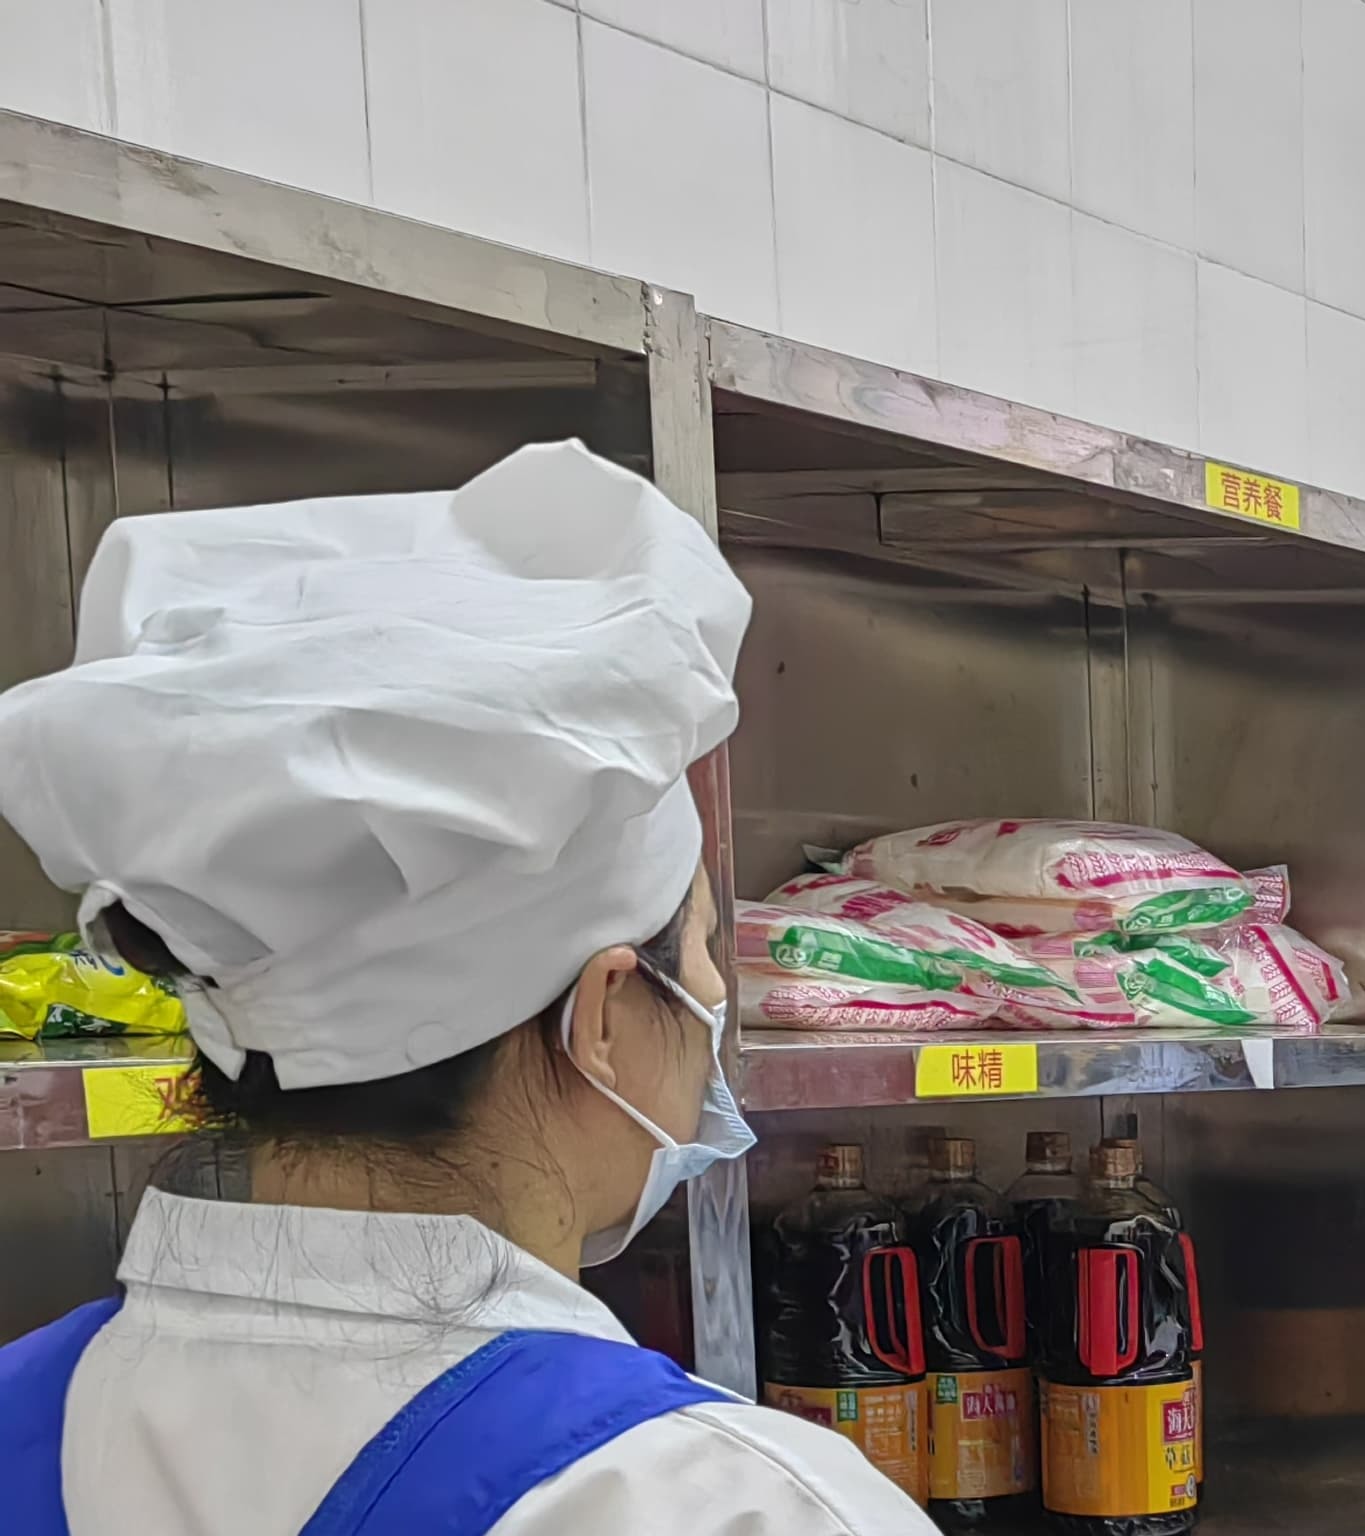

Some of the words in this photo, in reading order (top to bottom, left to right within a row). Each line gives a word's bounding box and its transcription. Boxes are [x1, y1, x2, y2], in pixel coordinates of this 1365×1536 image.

[1220, 471, 1284, 521] 营养餐
[951, 1049, 1003, 1090] 味精
